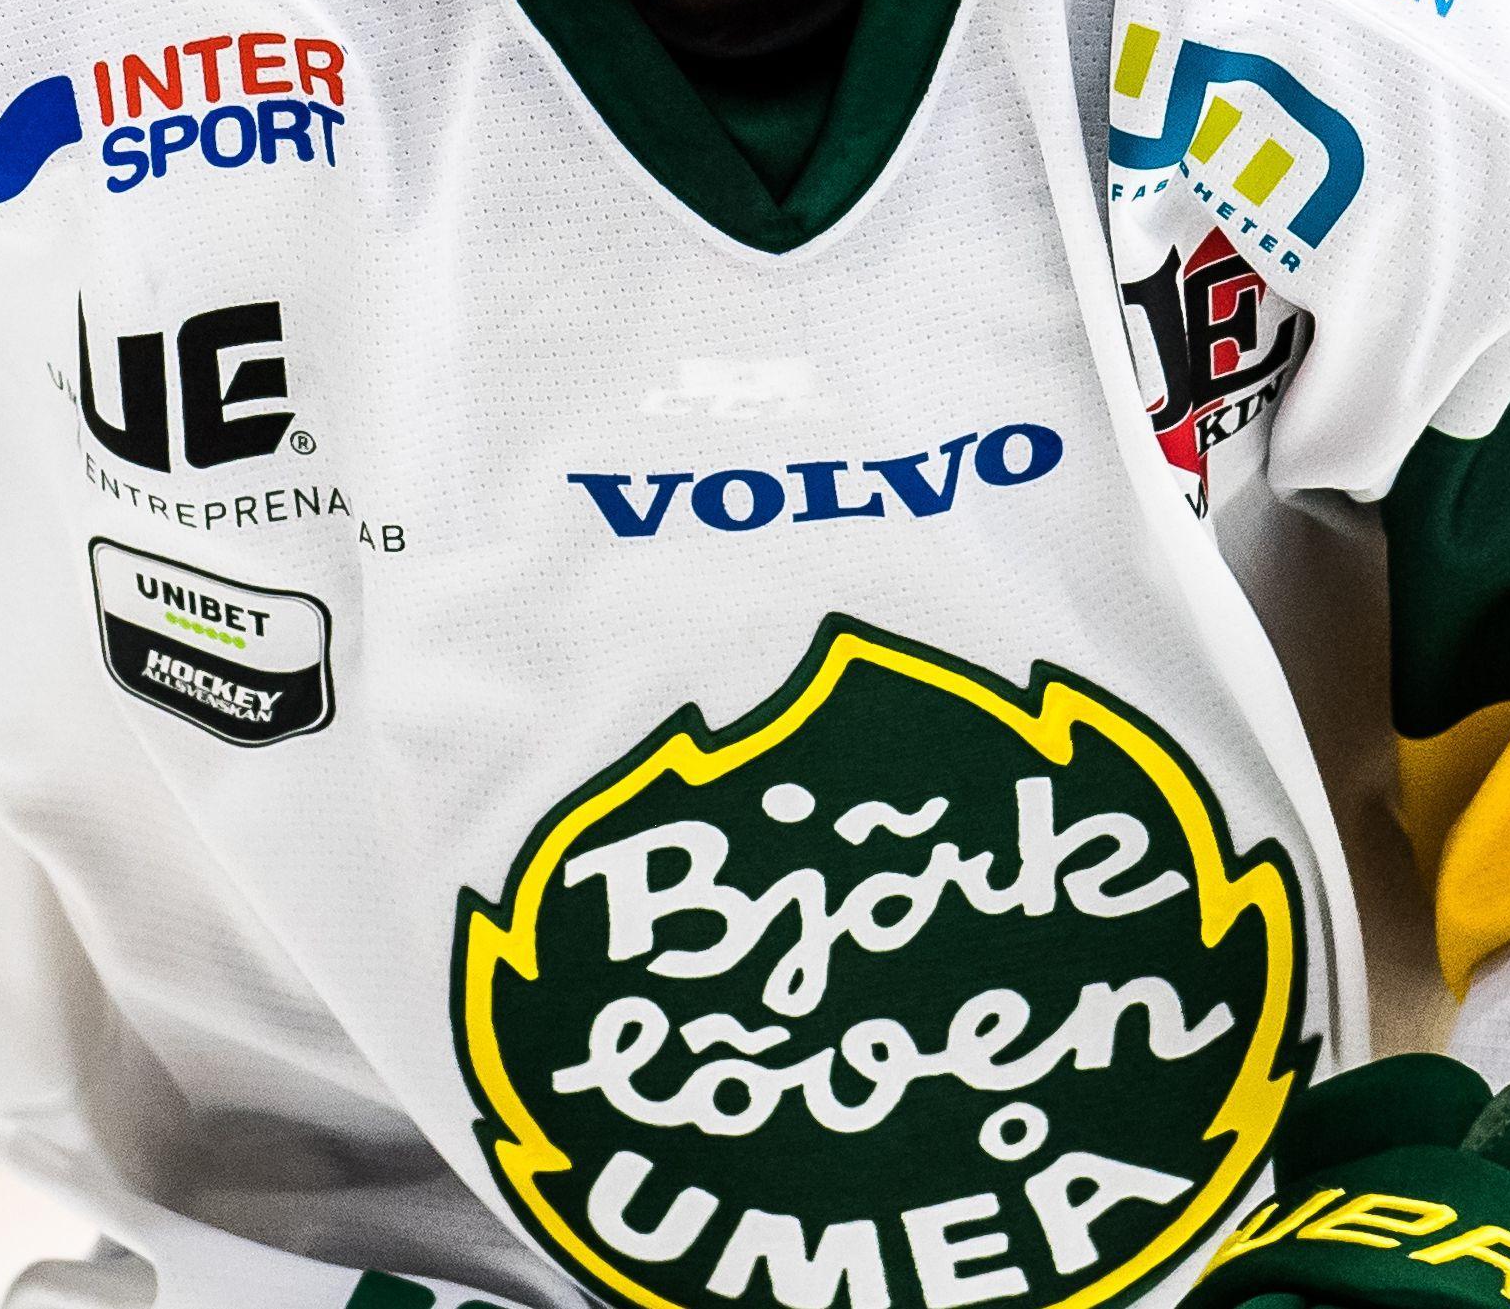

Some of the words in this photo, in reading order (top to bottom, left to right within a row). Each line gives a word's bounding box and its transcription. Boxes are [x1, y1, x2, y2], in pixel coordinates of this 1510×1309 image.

[94, 32, 345, 126] INTER
[101, 99, 346, 194] SPORT
[85, 451, 353, 530] ENTREPRENA
[359, 520, 406, 553] AB
[566, 423, 1064, 538] VOLVO
[135, 572, 271, 637] UNIBET
[146, 648, 284, 711] HOCKEY
[585, 1101, 1196, 1309] UMEÅ
